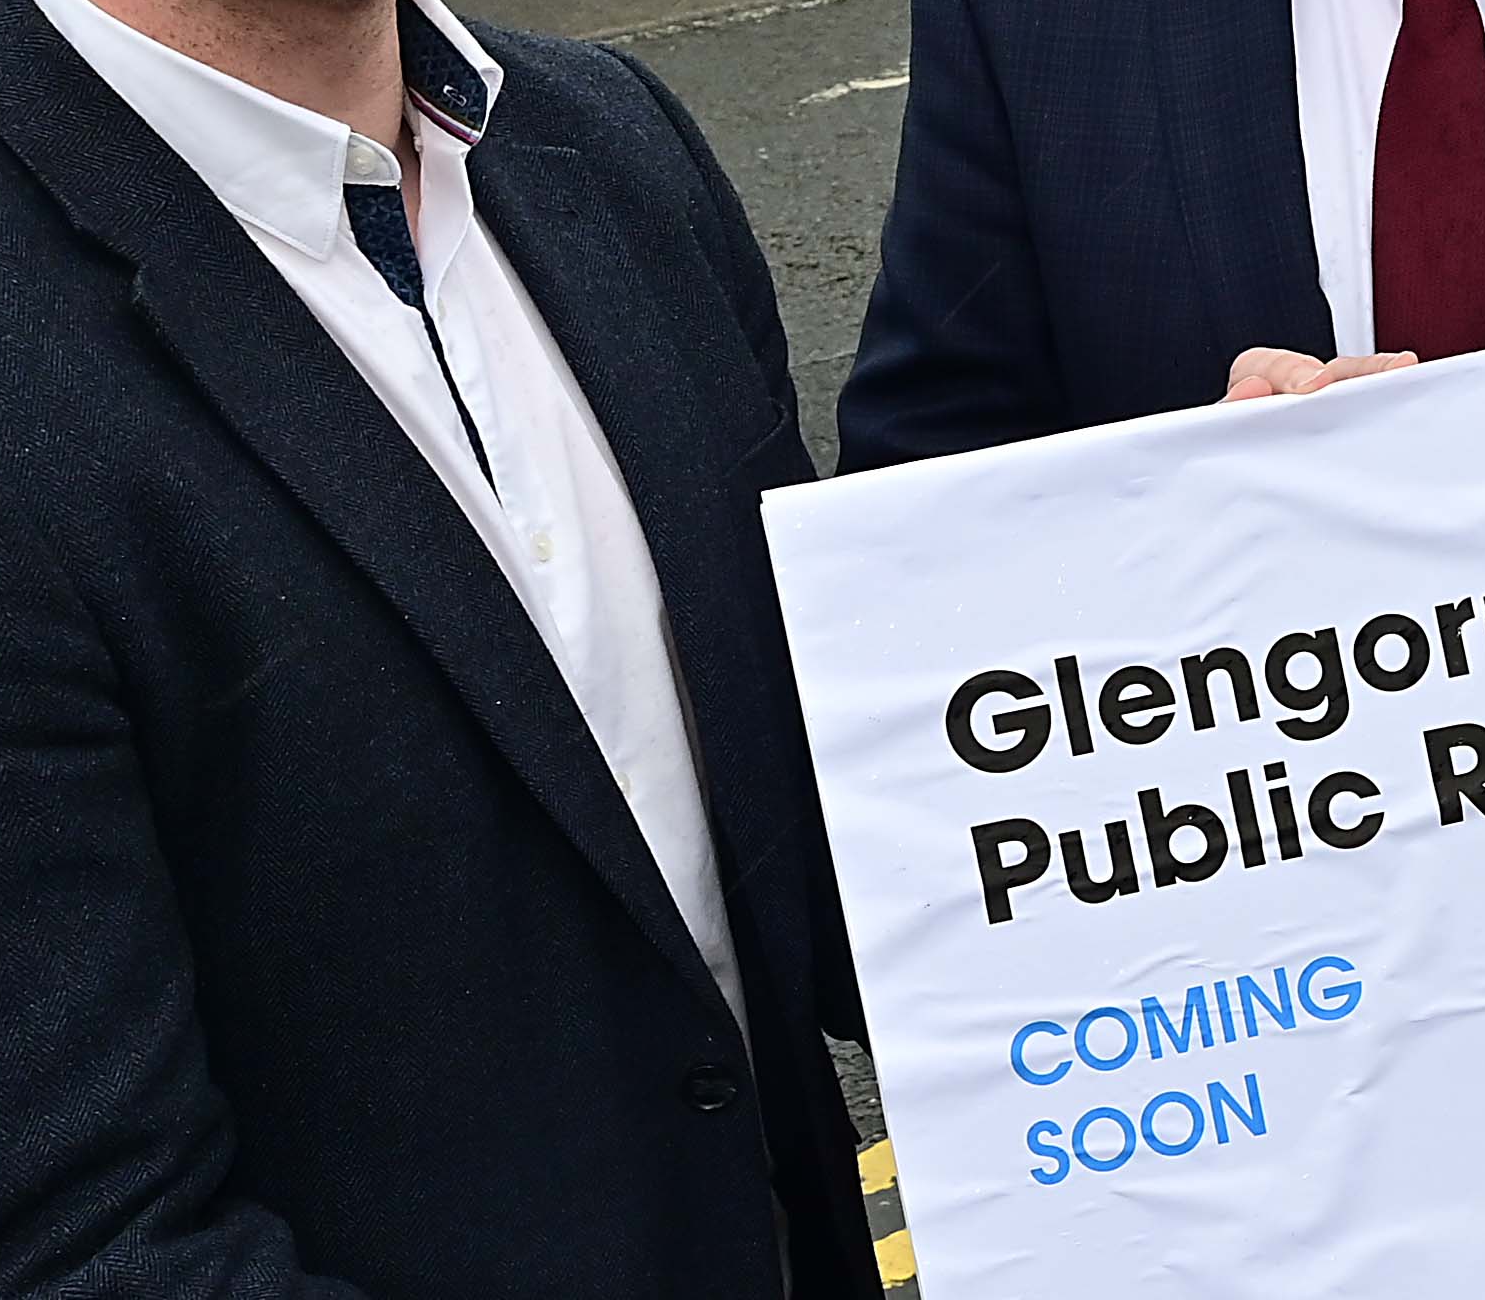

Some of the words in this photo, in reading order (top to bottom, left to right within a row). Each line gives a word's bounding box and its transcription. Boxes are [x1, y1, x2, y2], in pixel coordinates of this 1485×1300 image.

[970, 762, 1386, 925] Public
[1010, 955, 1363, 1086] COMING
[1026, 1073, 1268, 1185] SOON
